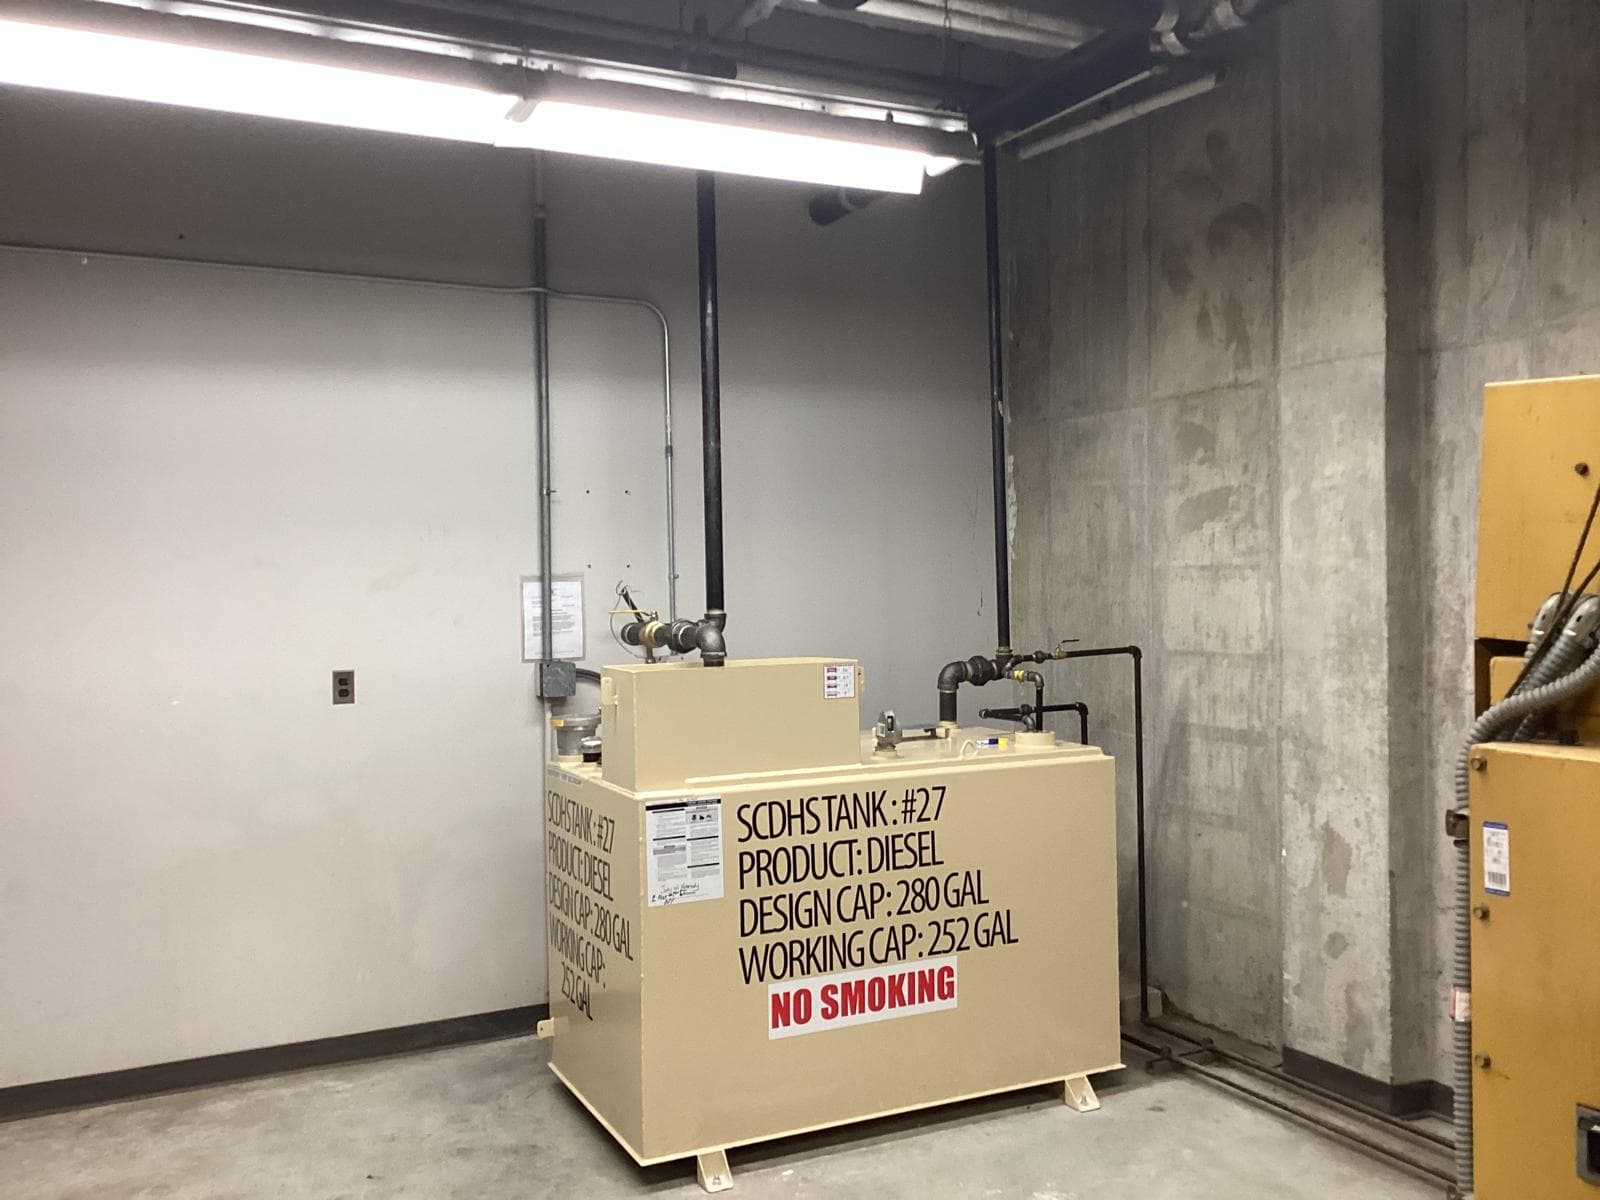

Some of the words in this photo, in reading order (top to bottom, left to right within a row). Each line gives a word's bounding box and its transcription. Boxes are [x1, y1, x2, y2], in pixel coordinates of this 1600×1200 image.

[597, 814, 615, 854] #27
[901, 786, 947, 825] #27
[548, 830, 583, 884] PRODUCT:
[584, 851, 613, 901] DIESEL
[738, 839, 863, 890] PRODUCT:
[866, 830, 944, 874] DIESEL
[548, 872, 574, 920] DESIGN
[574, 890, 593, 934] CAP:
[594, 902, 611, 946] 280
[612, 914, 633, 961] GAL
[738, 888, 831, 938] DESIGN
[836, 882, 893, 923] CAP:
[896, 875, 940, 916] 280
[943, 869, 990, 908] GAL
[549, 911, 584, 972] WORKING
[585, 941, 606, 989] CAP:
[738, 930, 865, 985] WORKING
[869, 923, 924, 965] CAP:
[927, 916, 970, 956] 252
[973, 909, 1019, 948] GAL
[561, 961, 576, 1004] 252
[575, 975, 593, 1021] GAL
[771, 988, 812, 1029] NO
[820, 965, 955, 1021] SMOKING
